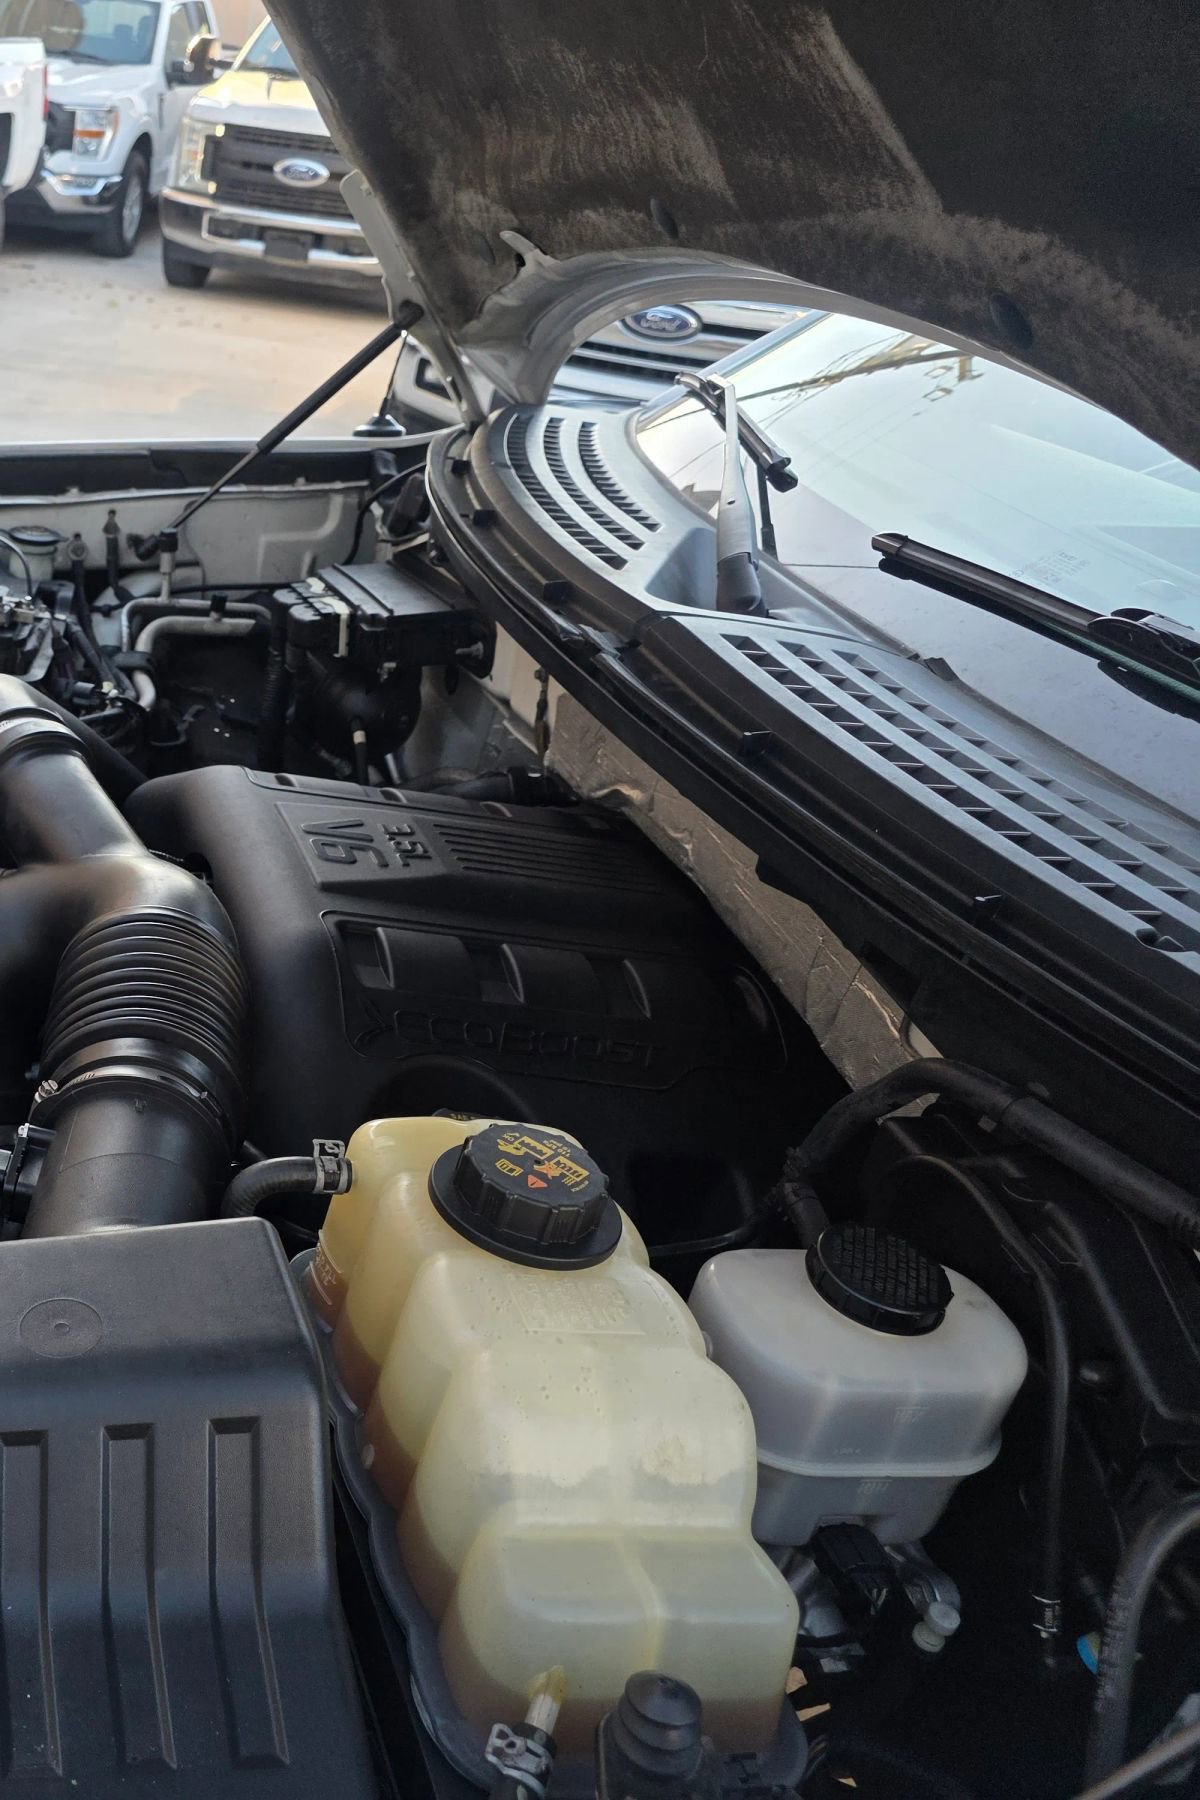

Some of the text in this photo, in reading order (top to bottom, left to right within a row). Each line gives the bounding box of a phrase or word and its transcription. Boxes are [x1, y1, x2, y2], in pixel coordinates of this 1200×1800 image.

[639, 309, 683, 332] Ford
[300, 818, 390, 868] V6
[377, 823, 433, 868] 3.5L
